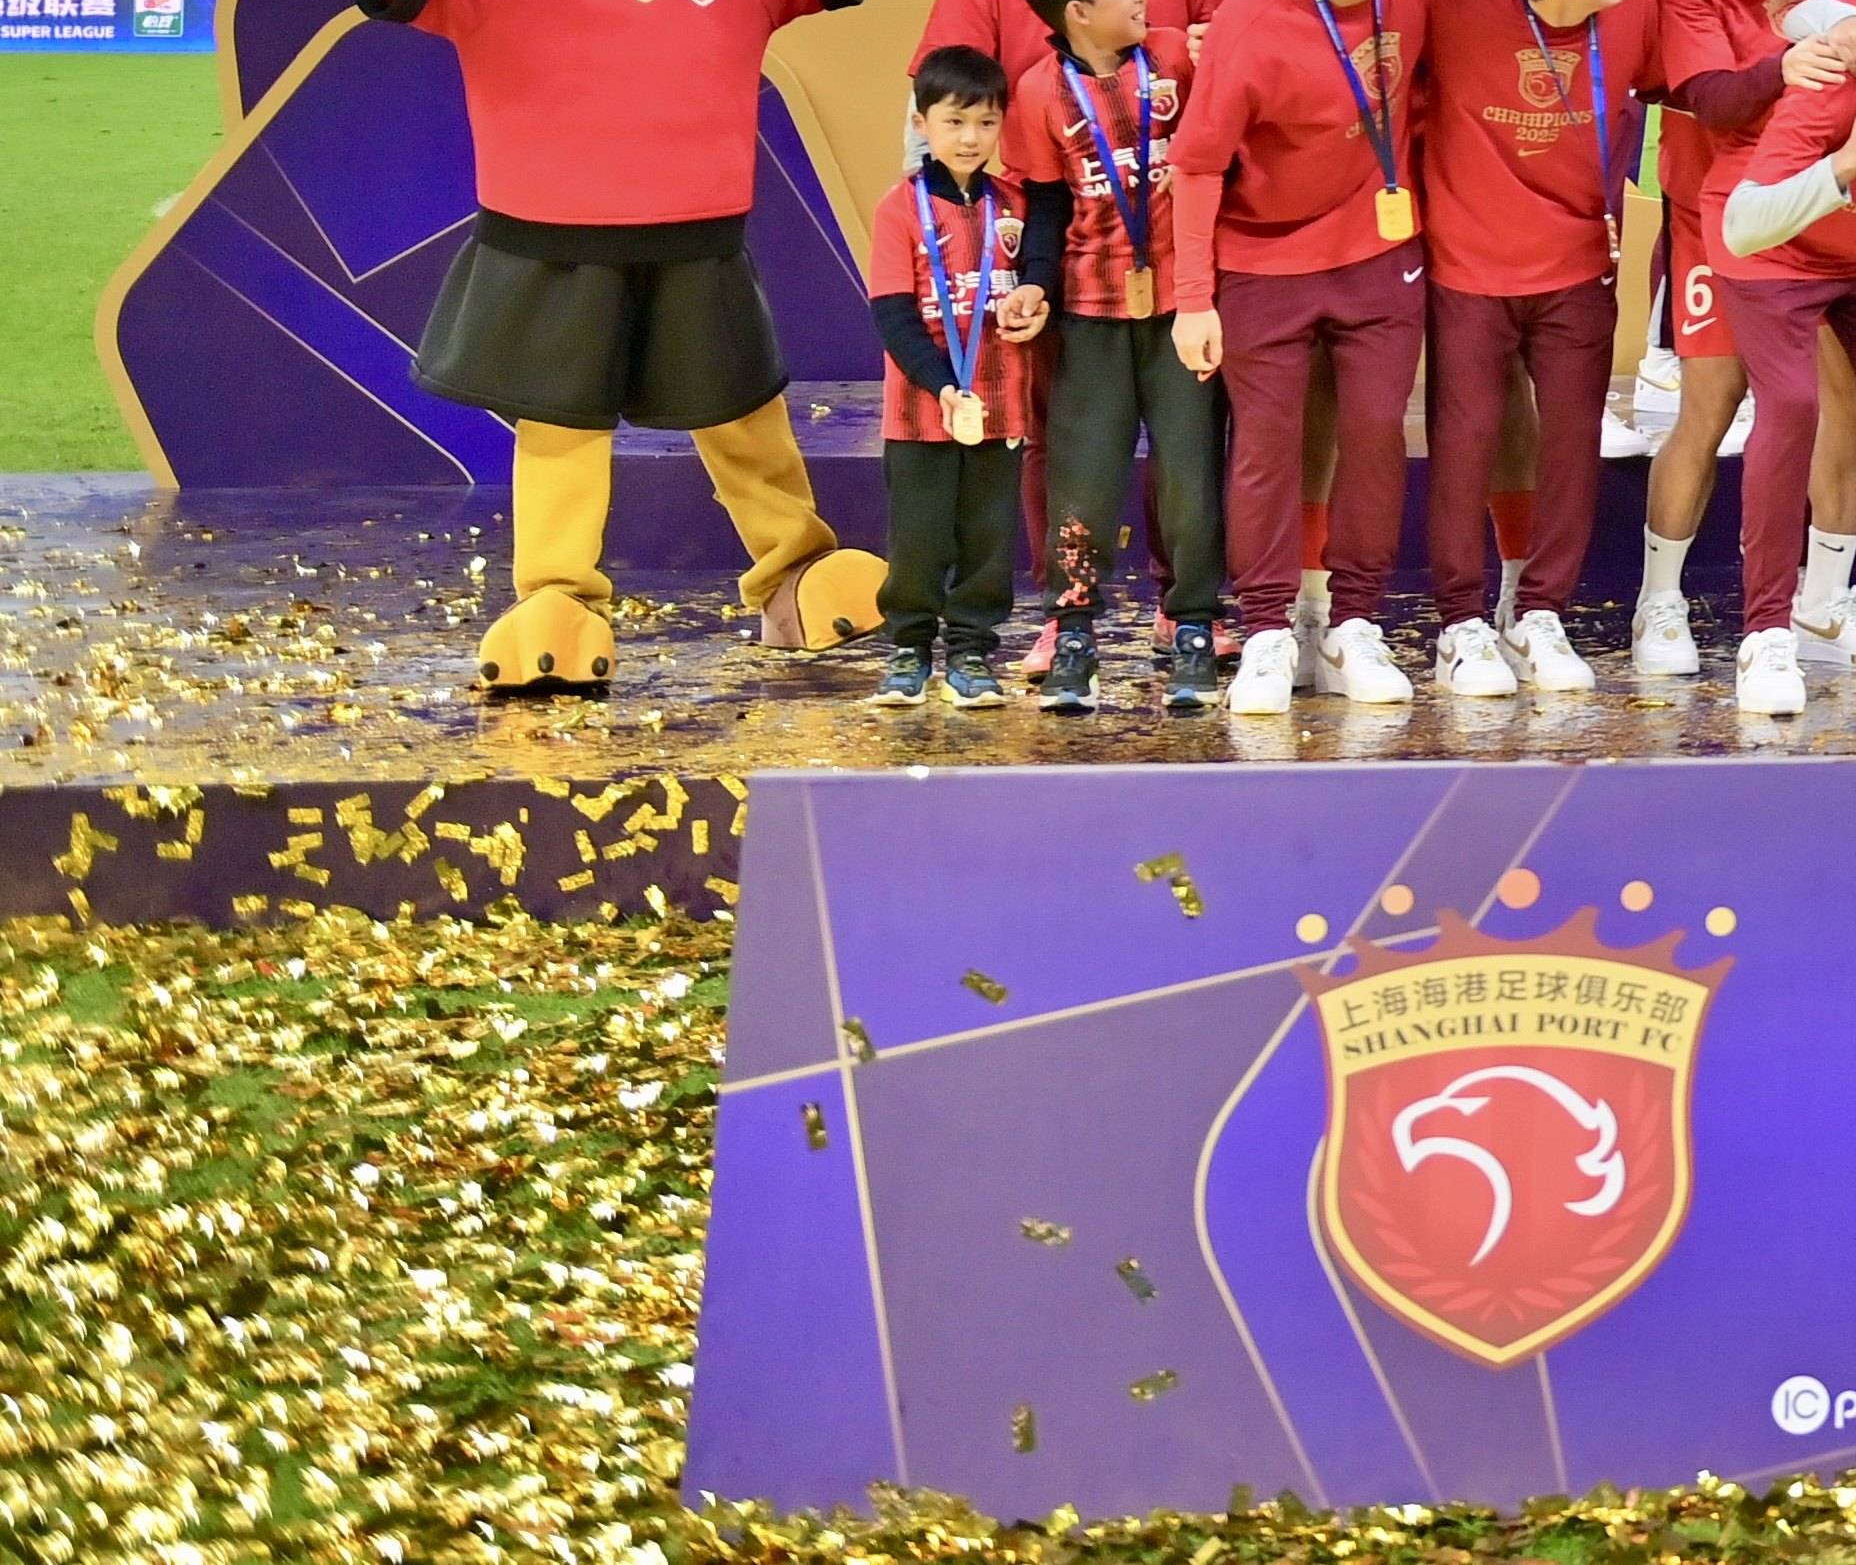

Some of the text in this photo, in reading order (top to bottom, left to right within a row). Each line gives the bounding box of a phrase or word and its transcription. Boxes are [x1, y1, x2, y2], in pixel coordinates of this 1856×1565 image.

[1, 25, 115, 39] SUPER LEAGUE
[1482, 105, 1594, 126] CHAMPIONS
[1514, 127, 1559, 143] 2025
[1684, 265, 1713, 316] 6
[1337, 969, 1689, 1034] 上海海港足球俱乐部
[1343, 1012, 1684, 1060] SHANGHAI PORT FC
